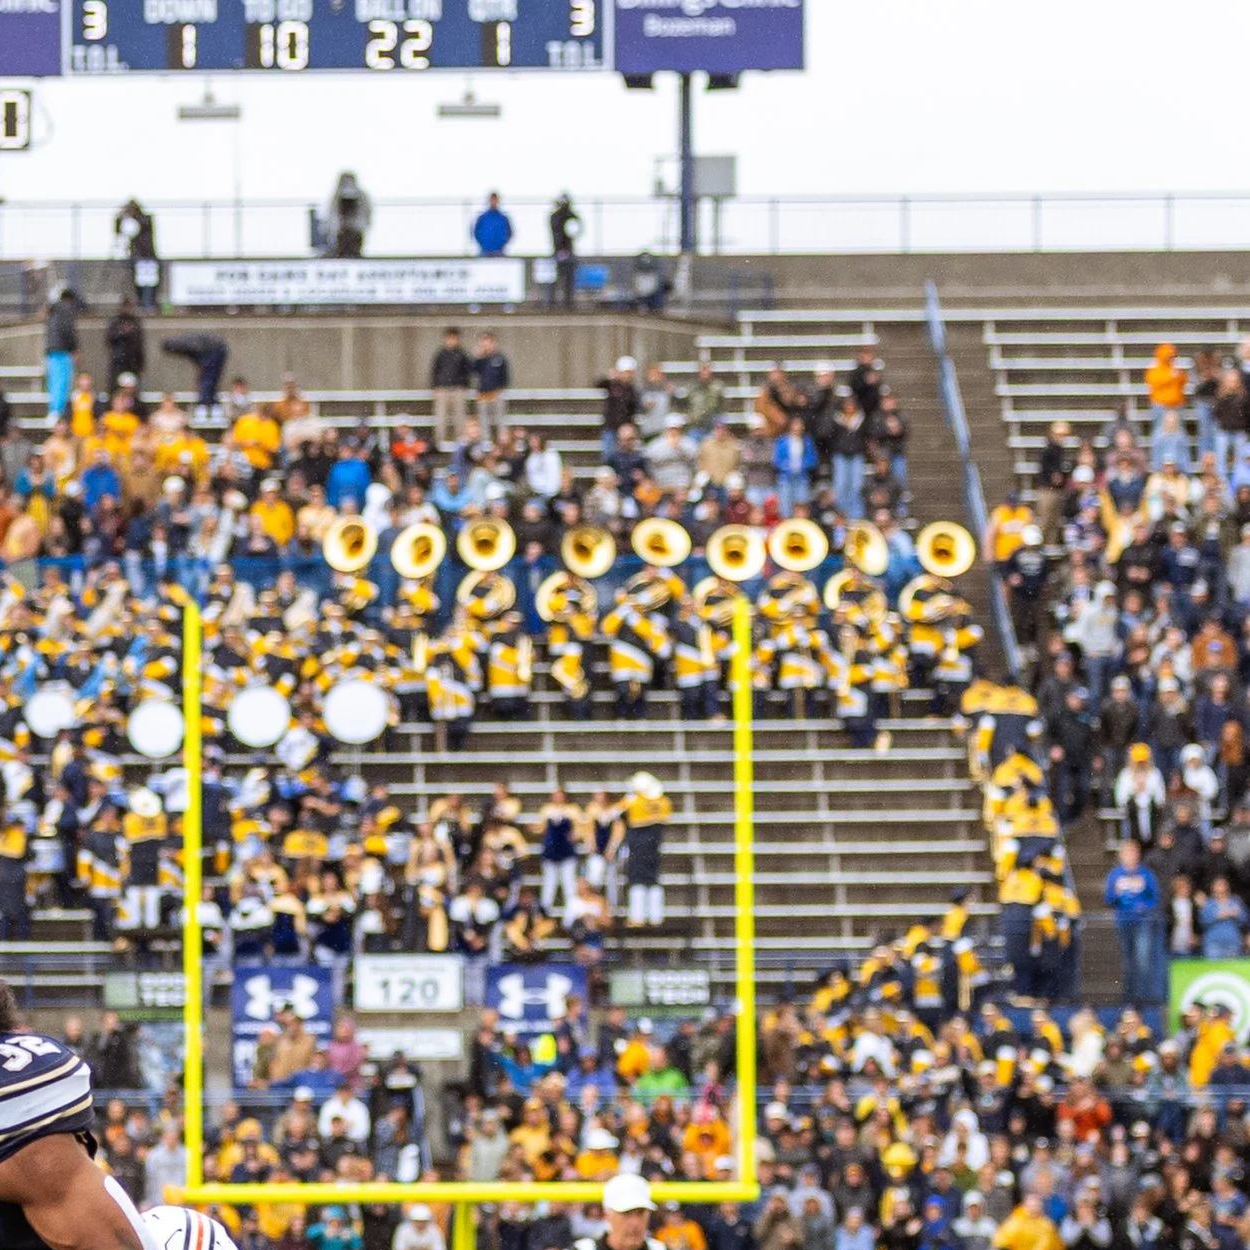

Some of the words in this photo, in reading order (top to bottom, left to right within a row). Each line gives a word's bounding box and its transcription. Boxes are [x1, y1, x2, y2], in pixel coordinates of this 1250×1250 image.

[83, 0, 107, 40] 3
[569, 0, 594, 36] 3
[643, 13, 736, 37] Bozeman
[182, 24, 196, 68] 1
[260, 21, 309, 70] 10
[365, 20, 433, 70] 22
[496, 21, 511, 66] 1
[378, 978, 441, 1002] 120
